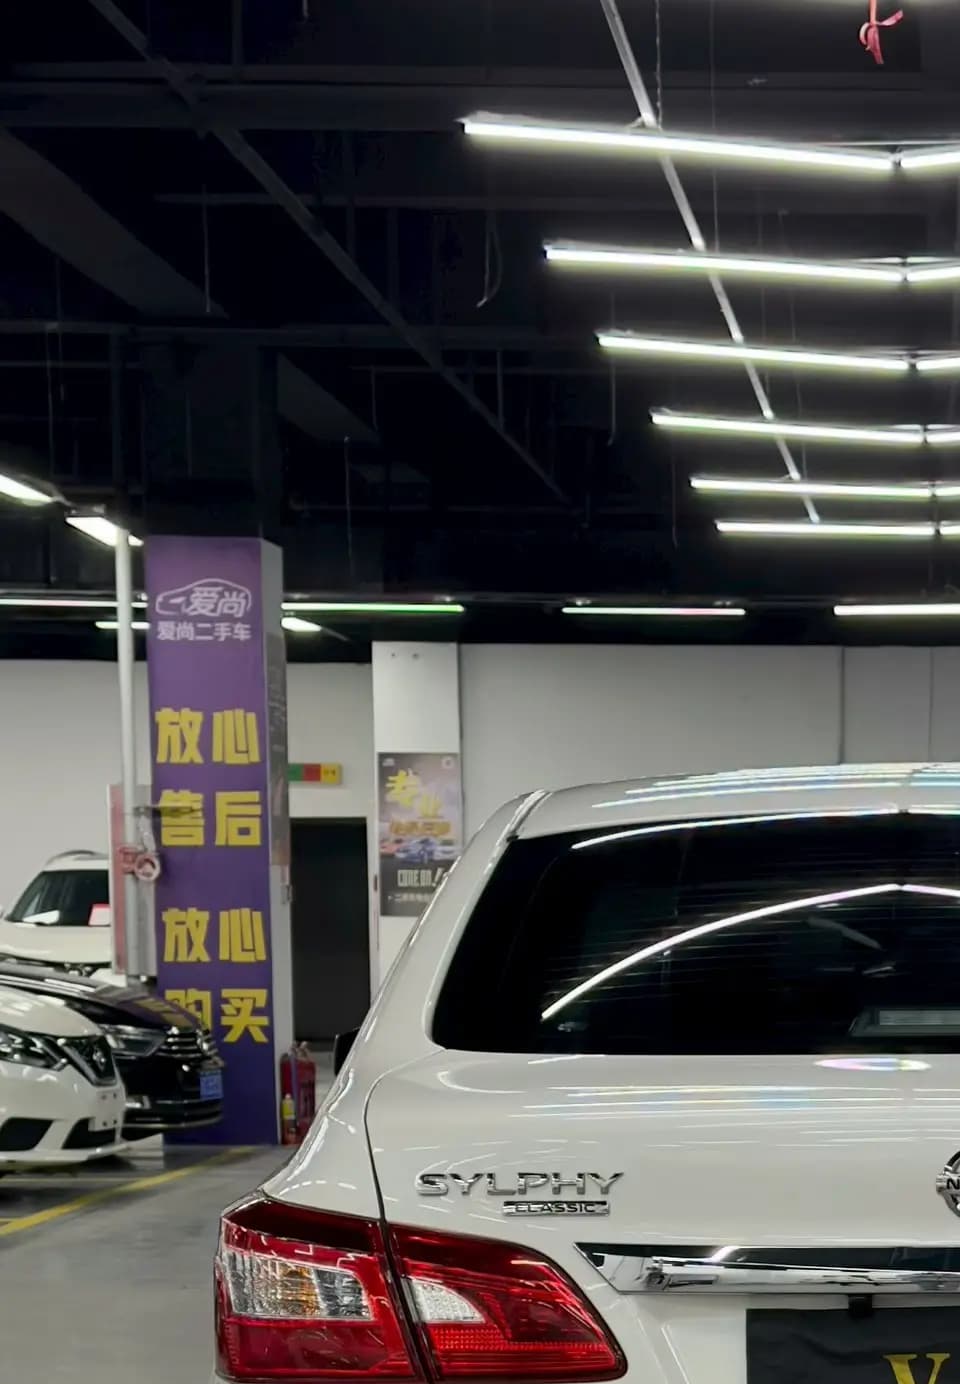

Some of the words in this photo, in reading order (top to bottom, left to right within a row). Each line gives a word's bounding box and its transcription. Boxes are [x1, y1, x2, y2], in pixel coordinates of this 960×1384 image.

[187, 587, 247, 618] 爱尚
[157, 621, 252, 641] 爱尚二手车
[155, 707, 260, 765] 放心
[162, 907, 267, 963] 放心
[417, 1172, 624, 1196] SYLPHY
[514, 1202, 596, 1213] CLASSIC
